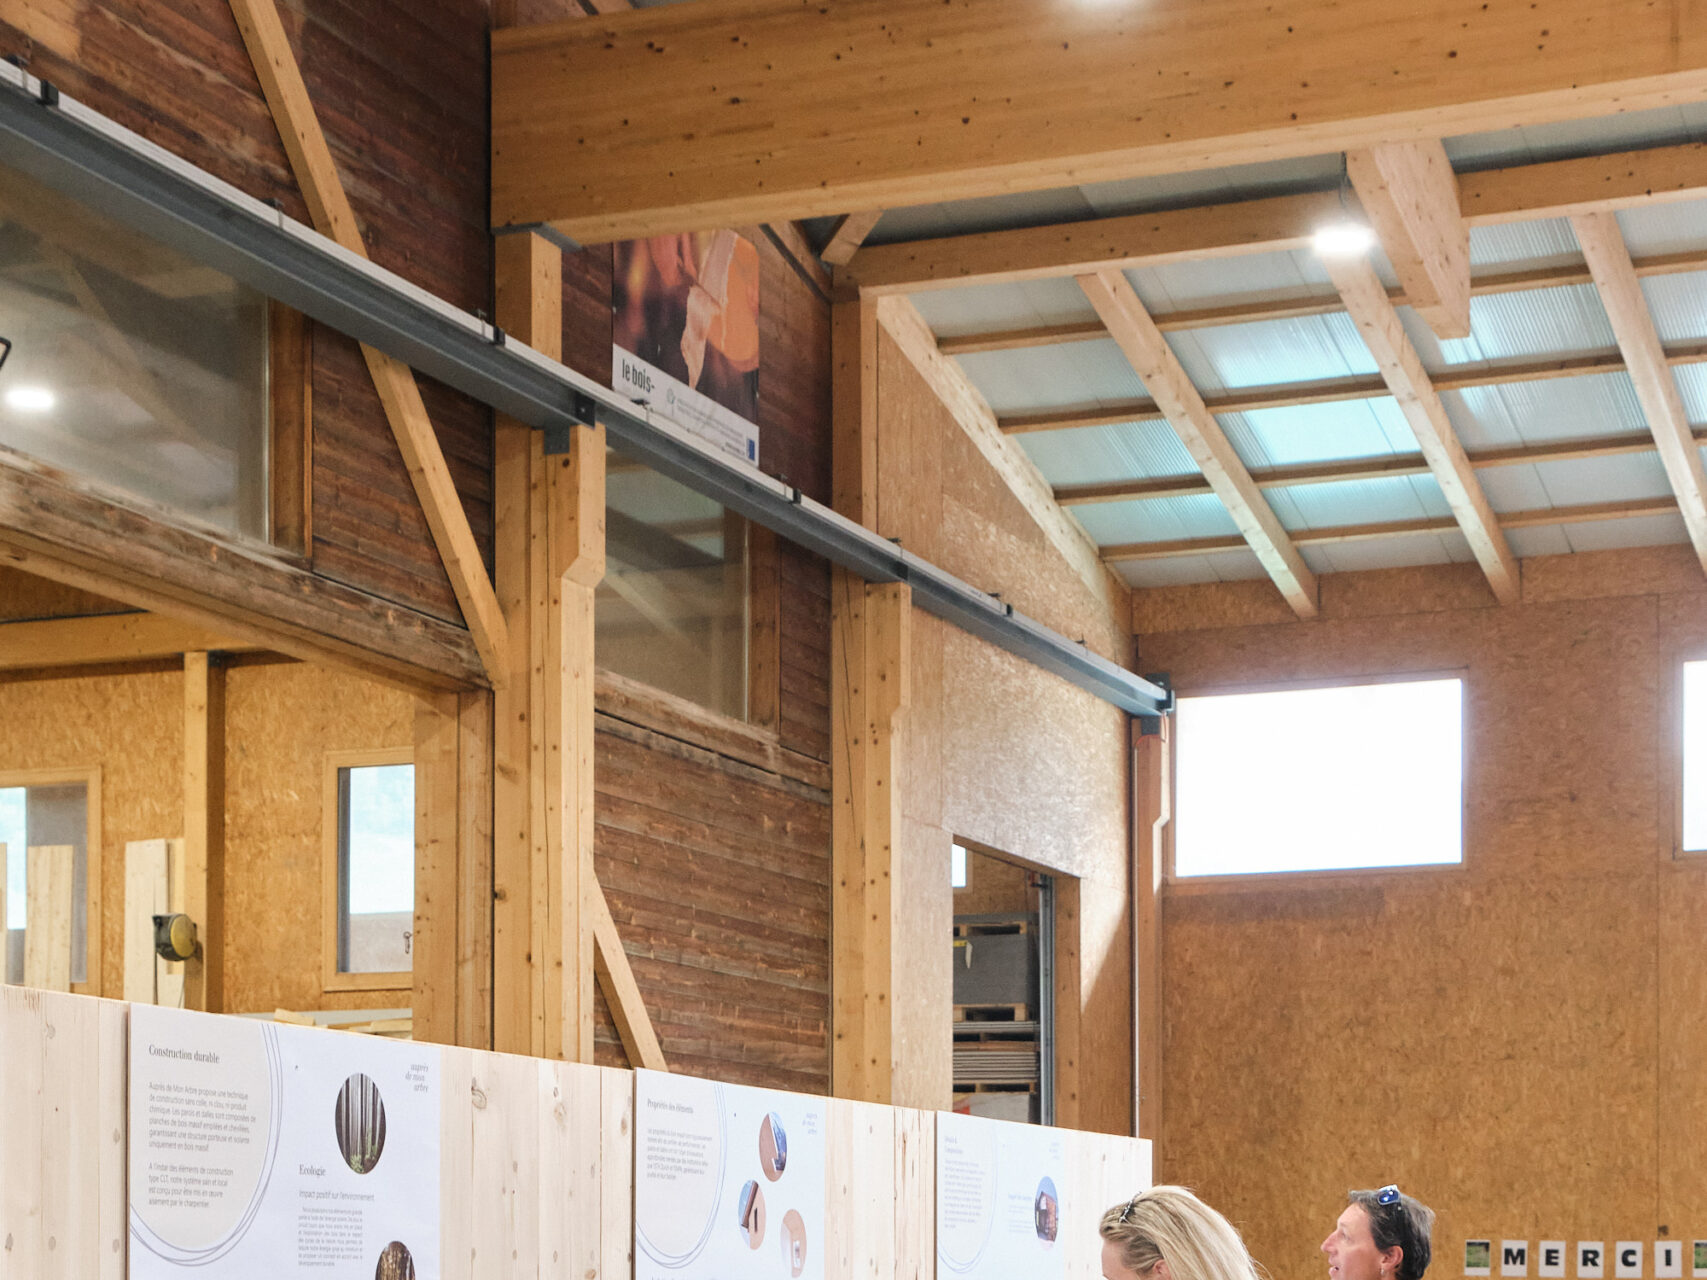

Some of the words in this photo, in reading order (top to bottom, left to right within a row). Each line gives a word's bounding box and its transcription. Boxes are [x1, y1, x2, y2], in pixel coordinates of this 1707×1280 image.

[622, 359, 631, 381] le
[149, 1044, 192, 1060] Construction
[194, 1049, 220, 1064] durable
[299, 1164, 326, 1178] Ecologie
[299, 1188, 315, 1199] Impact
[316, 1190, 331, 1201] positif
[340, 1191, 375, 1202] l'environnement
[1504, 1248, 1672, 1267] MERCI
